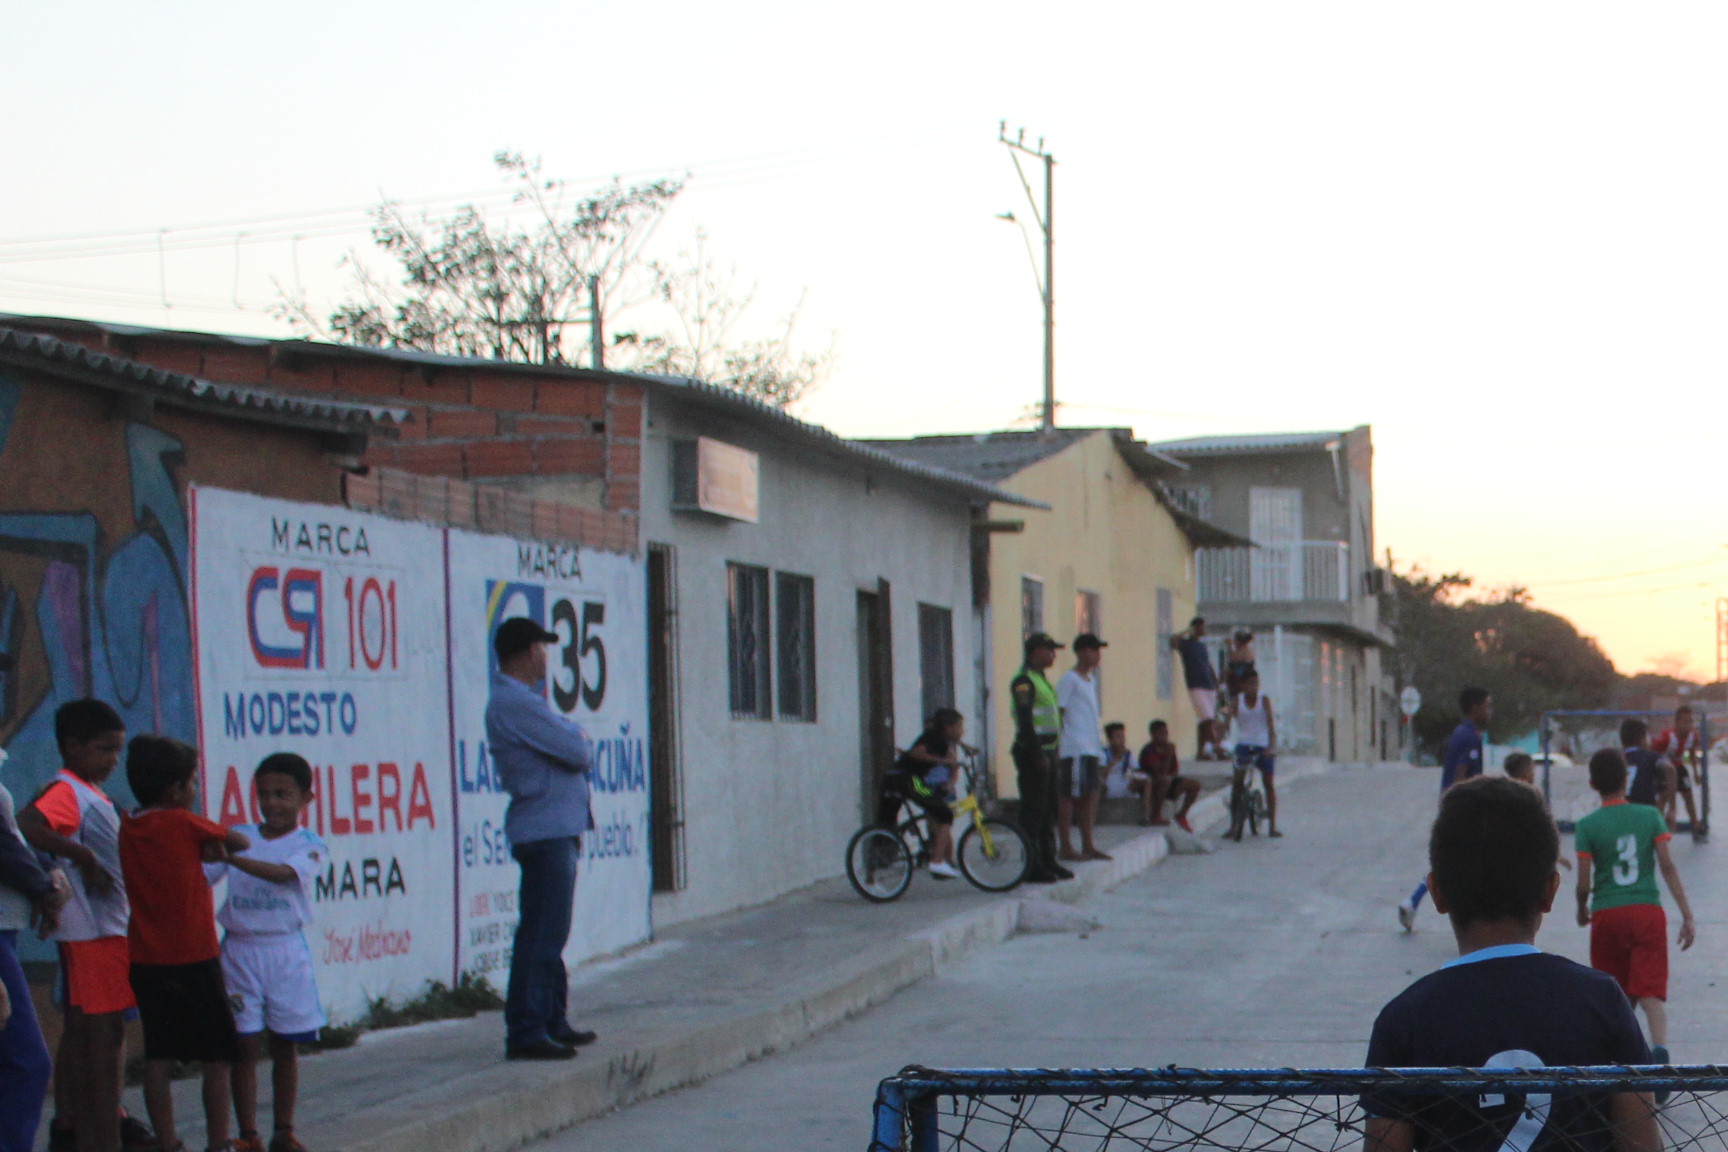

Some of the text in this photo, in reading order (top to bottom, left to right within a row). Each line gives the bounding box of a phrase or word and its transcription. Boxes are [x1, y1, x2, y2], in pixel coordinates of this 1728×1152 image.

[272, 516, 370, 555] MARCA
[517, 543, 583, 582] MARCA
[345, 575, 397, 671] 101
[552, 598, 607, 713] 35
[223, 691, 357, 740] MODESTO
[1611, 834, 1640, 887] 3
